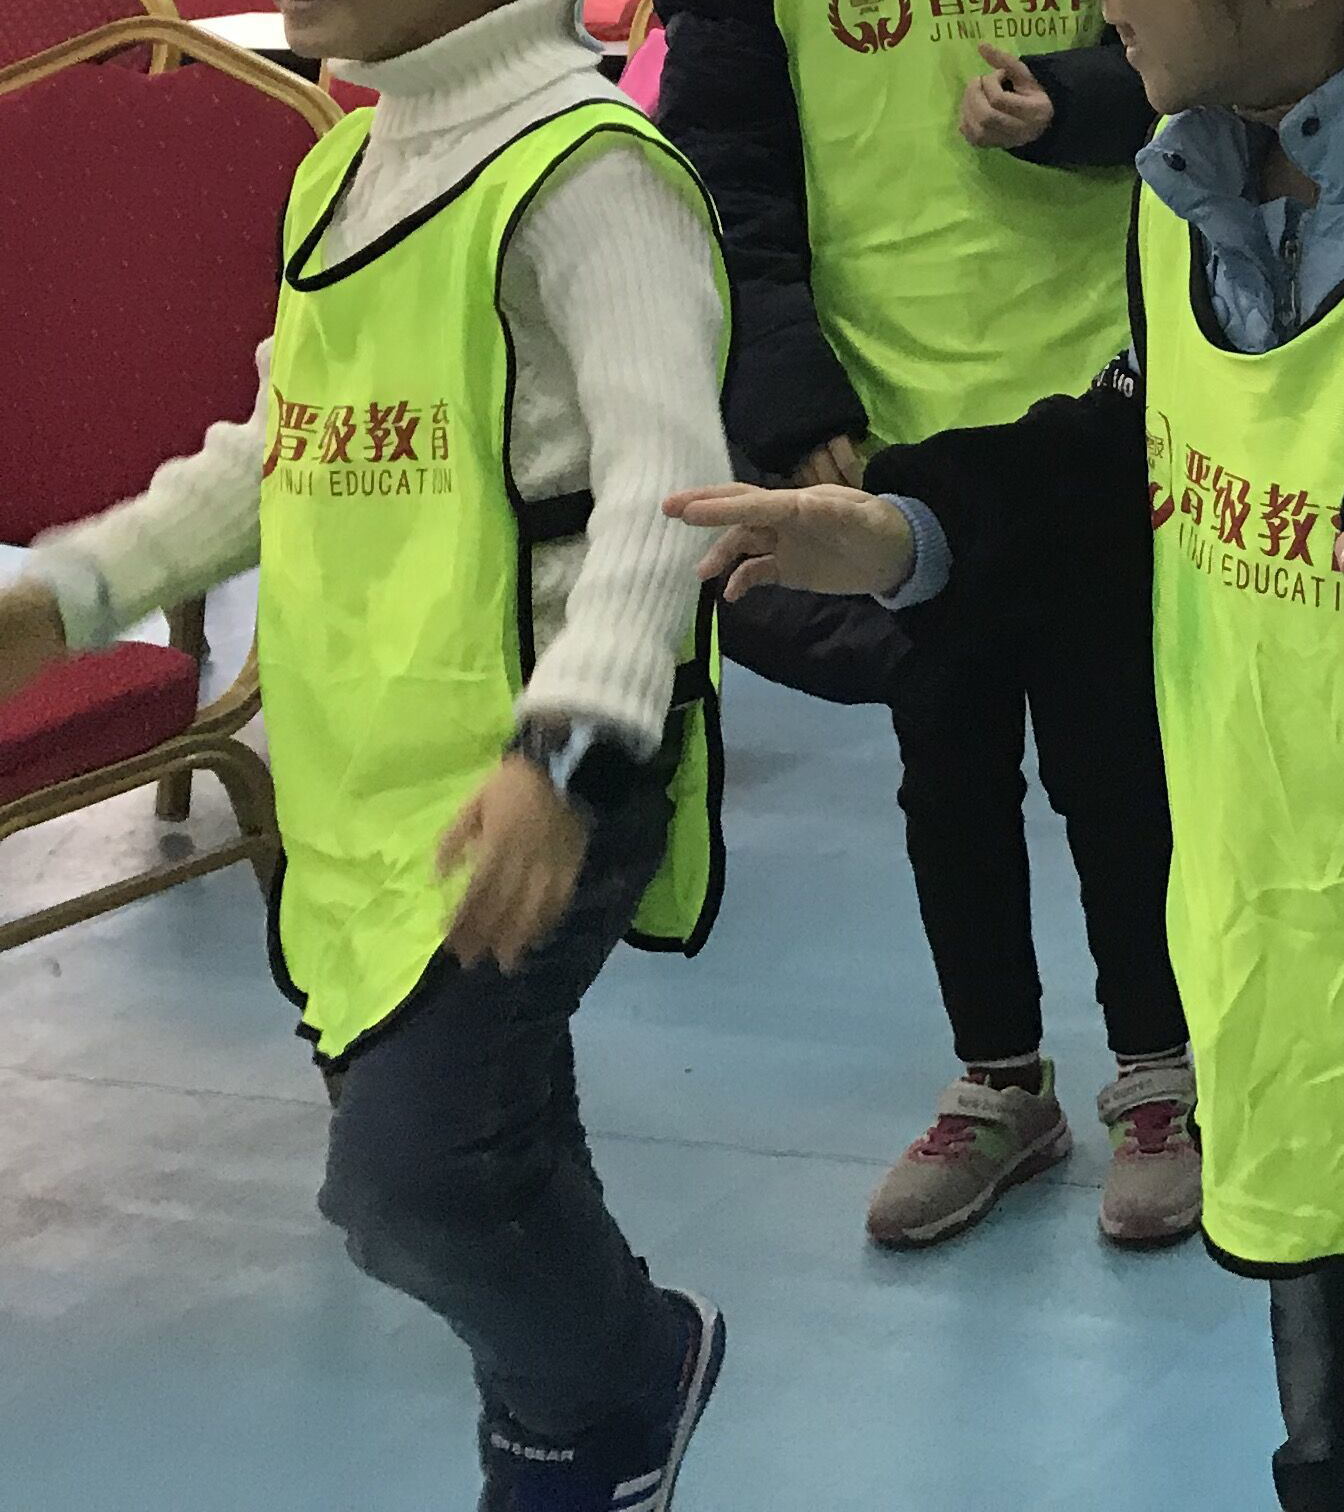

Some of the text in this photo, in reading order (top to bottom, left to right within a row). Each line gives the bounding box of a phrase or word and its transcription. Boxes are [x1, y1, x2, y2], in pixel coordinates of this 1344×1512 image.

[993, 14, 1094, 38] EDUCATIO
[278, 398, 450, 465] 晋级教育
[328, 467, 453, 497] EDUCATION
[1179, 443, 1342, 572] 晋级教
[1221, 553, 1341, 612] EDUCATI
